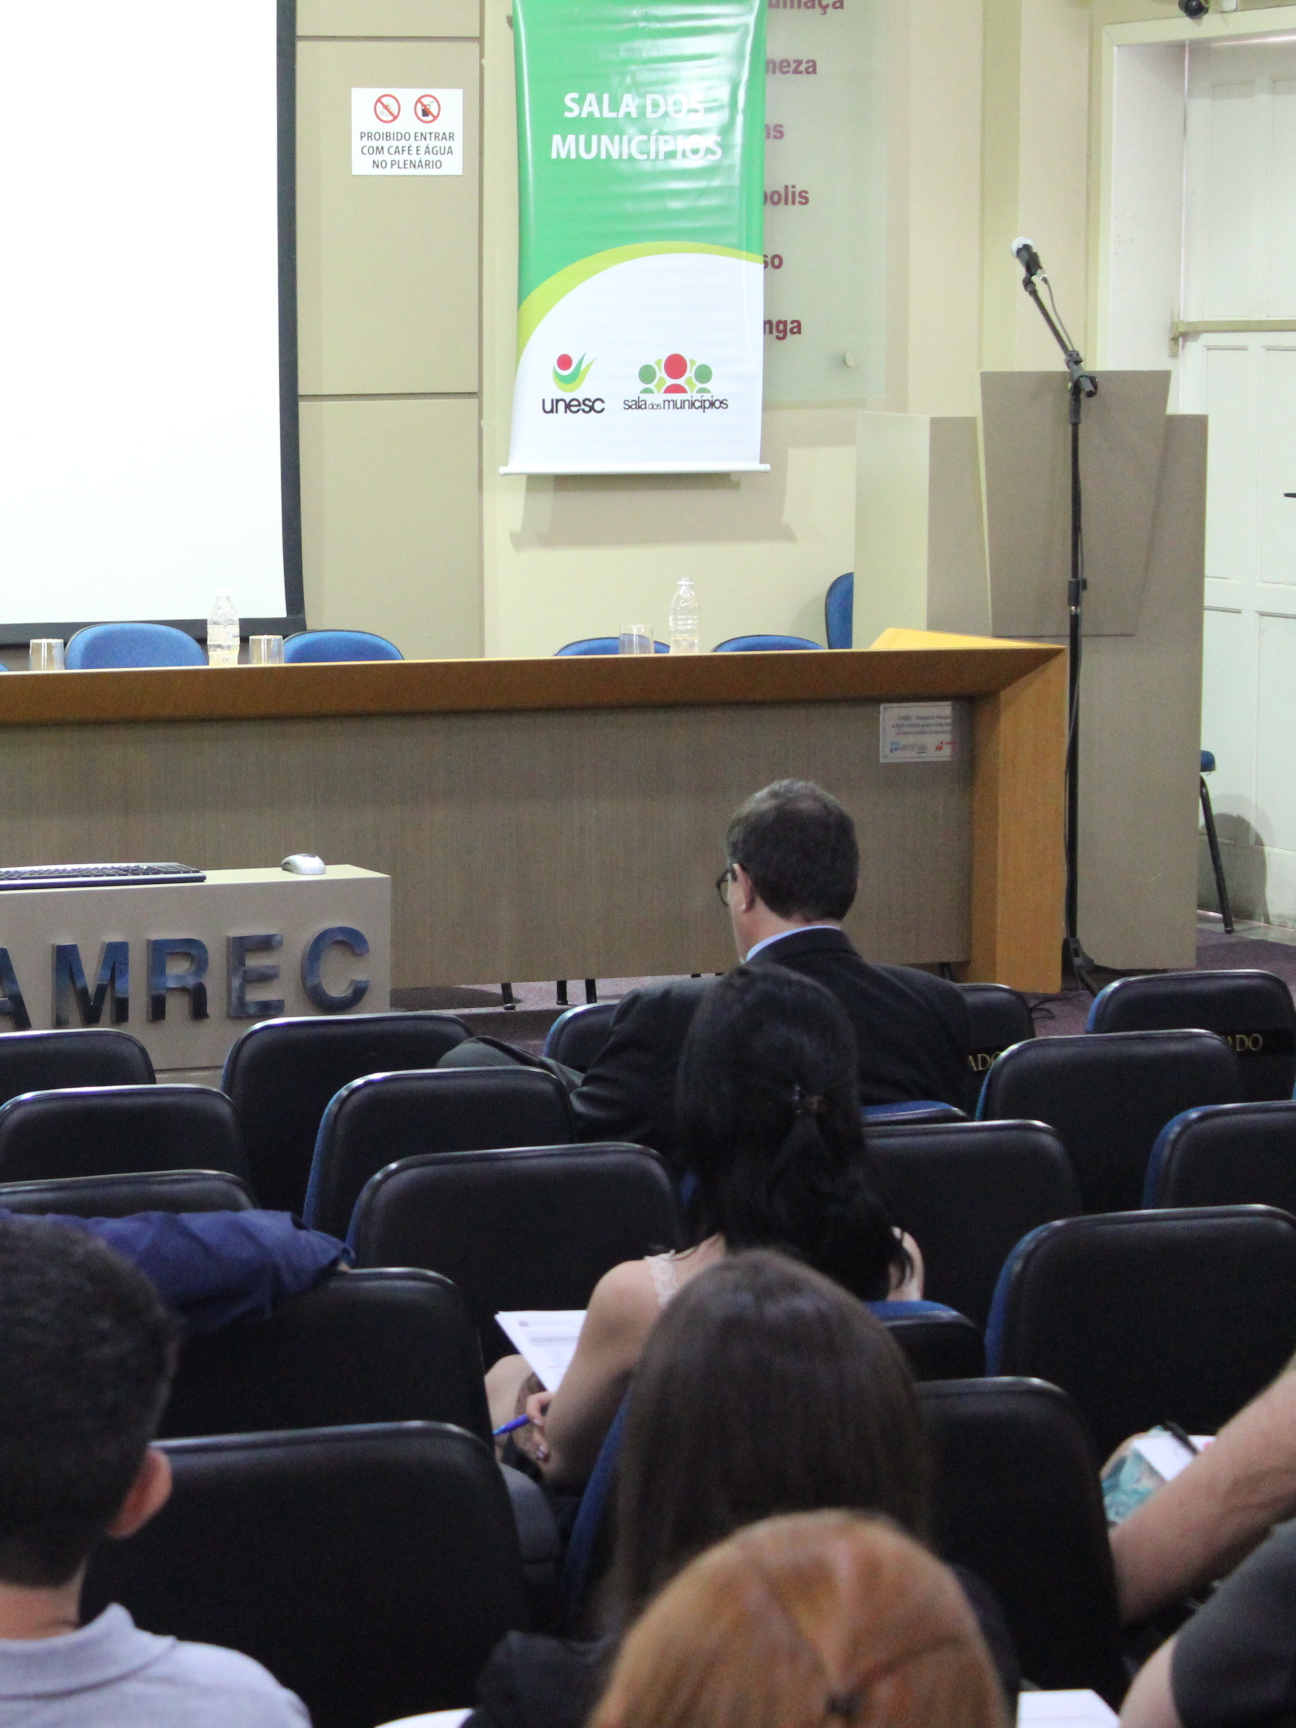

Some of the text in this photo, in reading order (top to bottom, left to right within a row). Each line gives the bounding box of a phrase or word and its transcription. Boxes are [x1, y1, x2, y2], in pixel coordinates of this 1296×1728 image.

[564, 92, 705, 119] SALA DOS
[360, 131, 455, 142] PROIBIDO ENTRAR
[551, 129, 723, 161] MUNICÍPIOS
[361, 143, 454, 156] COM CAFÉ E ÁGUA
[372, 157, 442, 169] NO PLENÁRIO
[764, 184, 810, 206] olis
[542, 397, 606, 415] unesc
[623, 395, 729, 413] sala dos municípios
